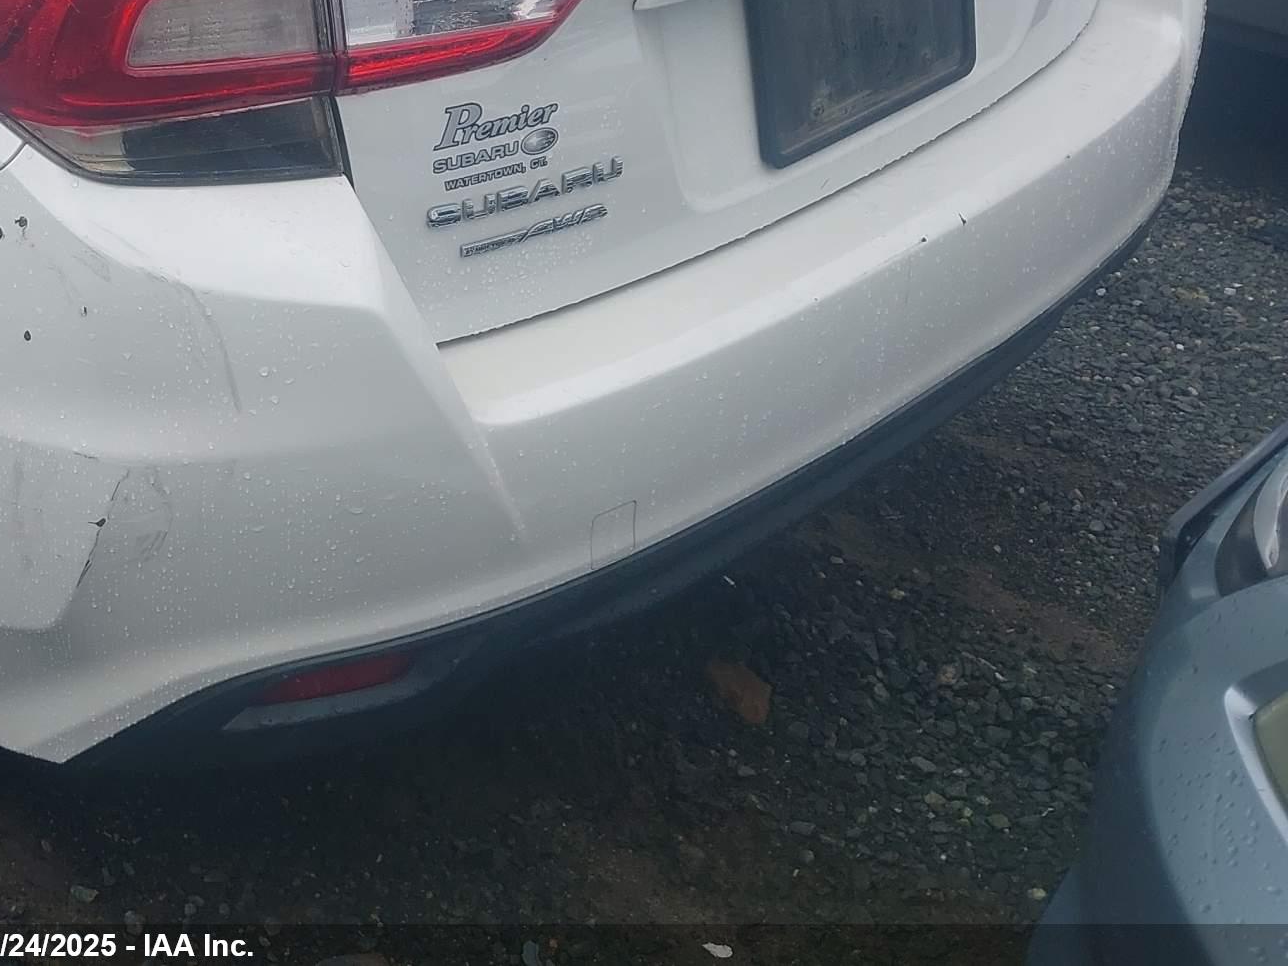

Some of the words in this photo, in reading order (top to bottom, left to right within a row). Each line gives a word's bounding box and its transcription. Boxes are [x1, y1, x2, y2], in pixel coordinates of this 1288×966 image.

[433, 102, 559, 152] Premier
[433, 140, 520, 175] SUBARU
[444, 161, 527, 192] WATERTOWN,
[426, 155, 625, 229] SUBARU
